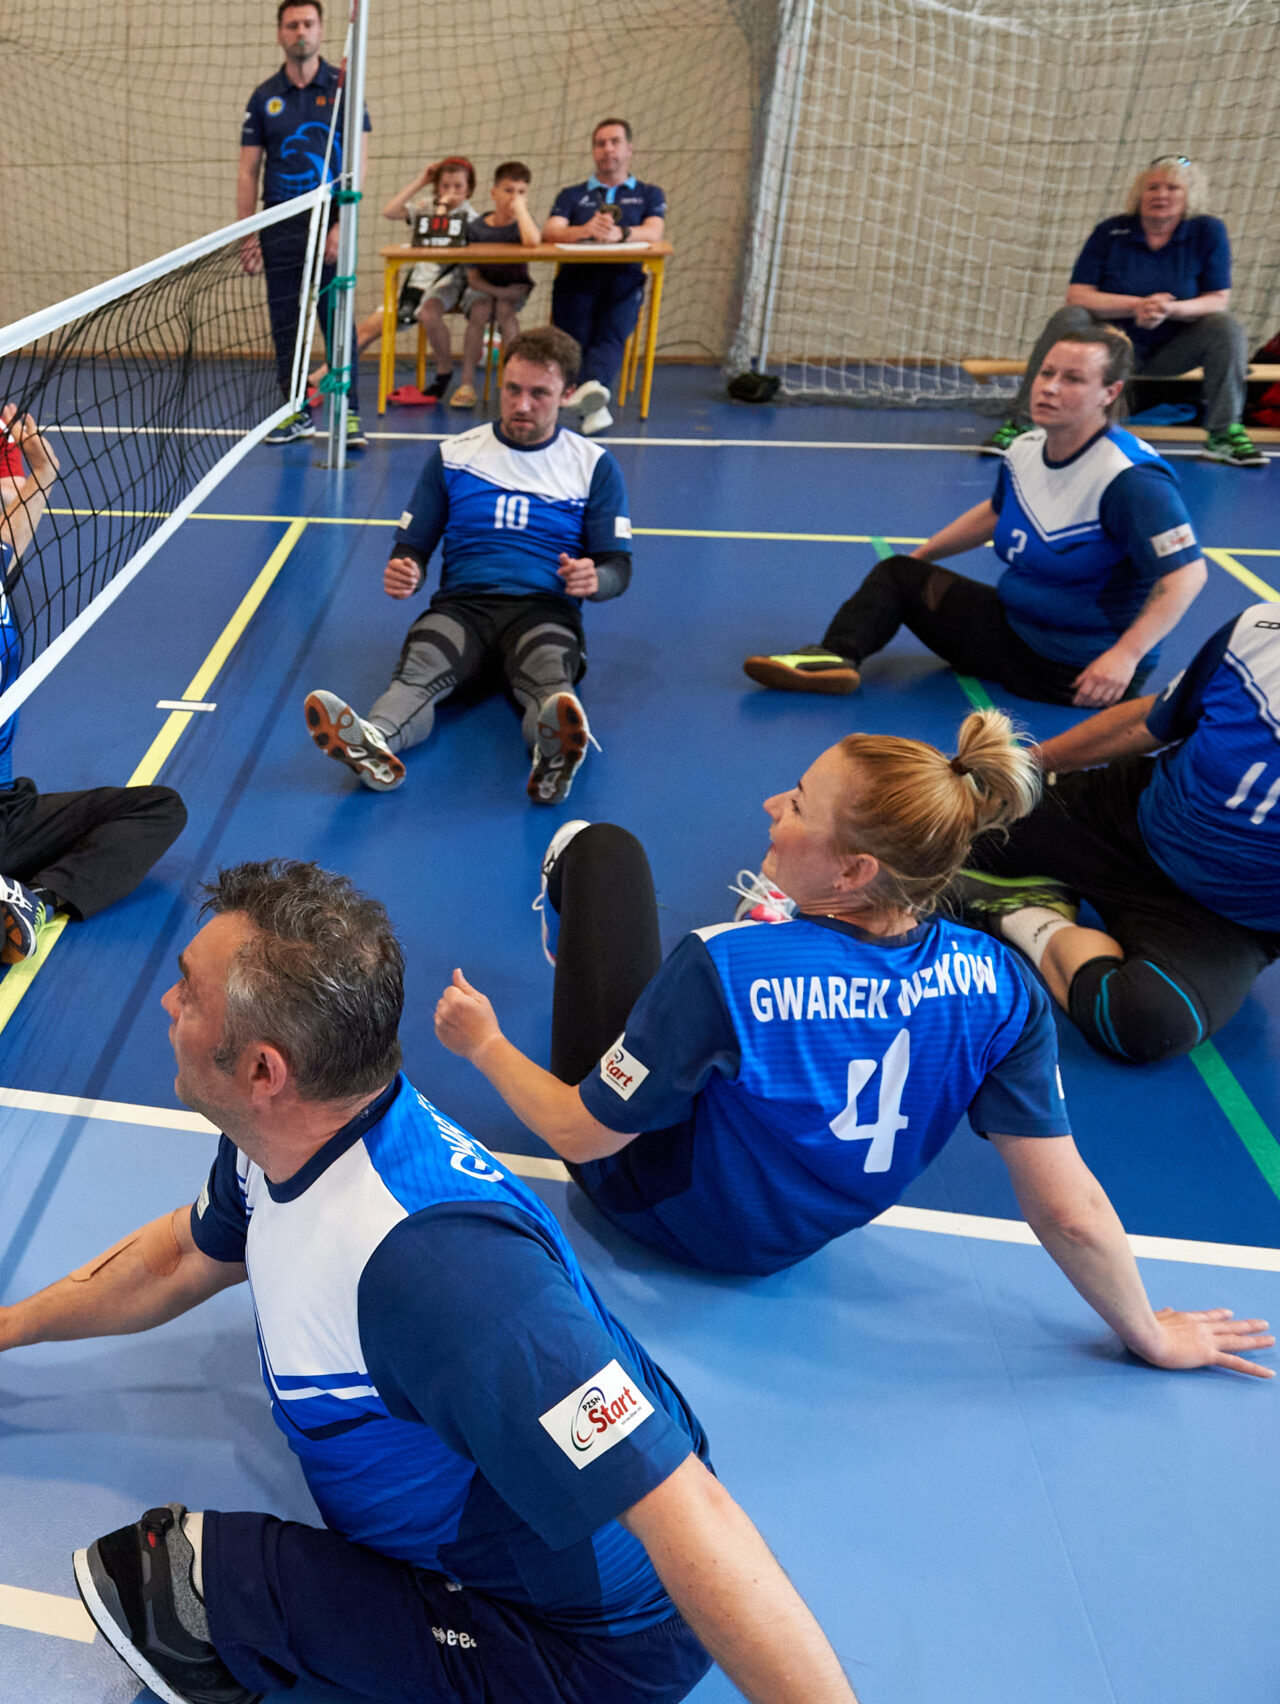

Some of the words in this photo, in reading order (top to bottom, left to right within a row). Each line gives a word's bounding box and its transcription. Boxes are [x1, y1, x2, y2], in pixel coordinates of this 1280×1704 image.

[494, 494, 531, 530] 10
[749, 976, 892, 1023] GWAREK
[828, 1027, 911, 1174] 4
[582, 1395, 601, 1412] PZSN
[588, 1386, 637, 1434] Start
